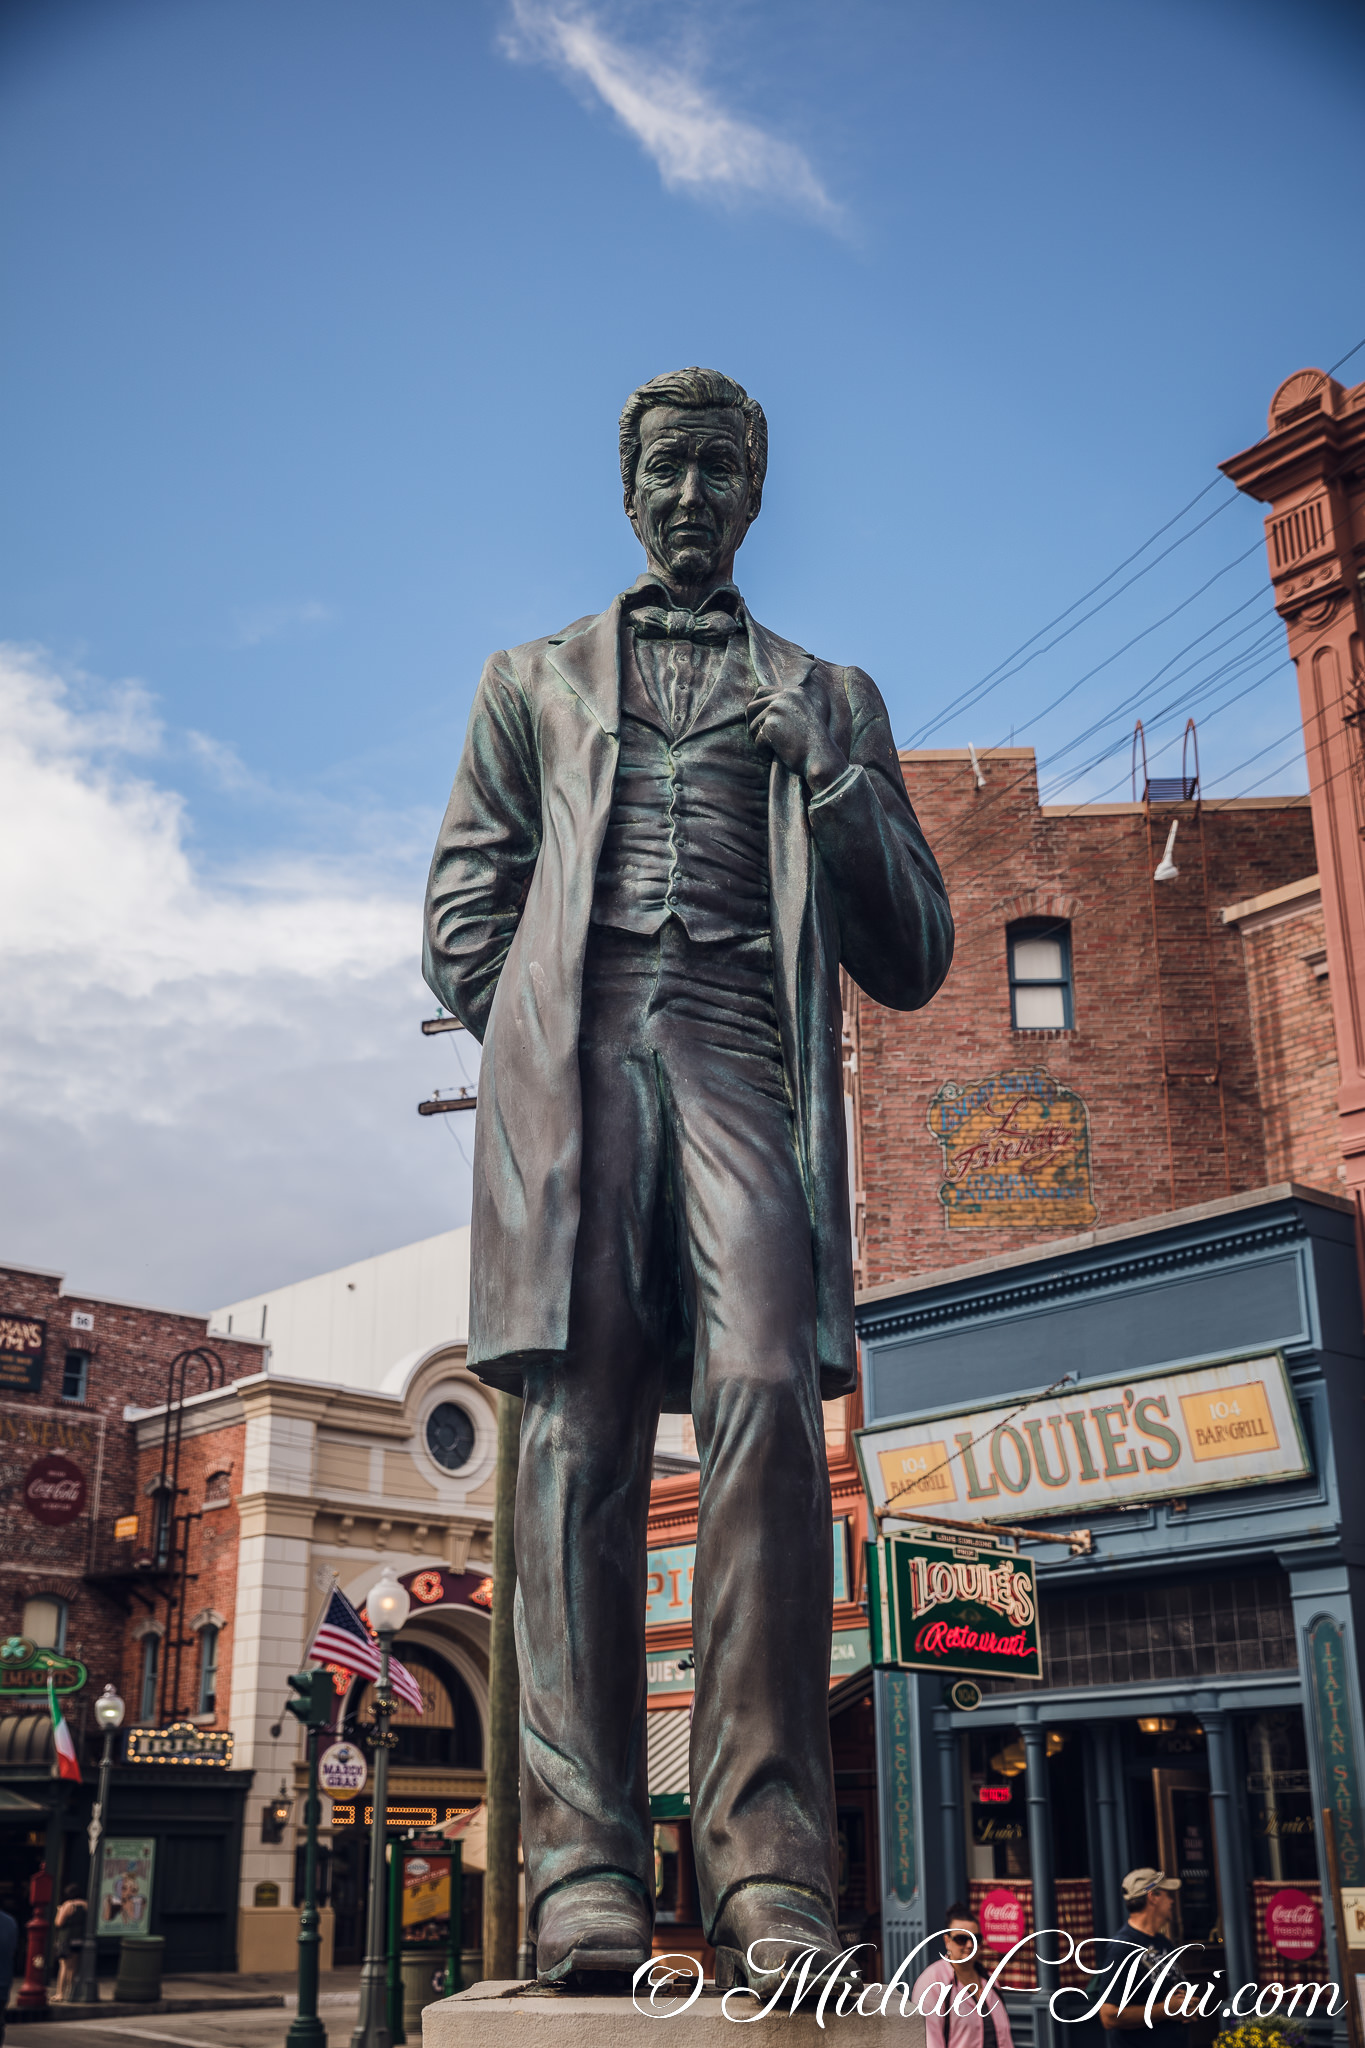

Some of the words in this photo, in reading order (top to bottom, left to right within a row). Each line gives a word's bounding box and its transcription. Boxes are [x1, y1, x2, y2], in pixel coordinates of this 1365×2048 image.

[941, 1080, 995, 1131] ESCORT
[1000, 1072, 1055, 1106] SERVICE
[955, 1187, 1085, 1201] ENTERTAINMENT
[967, 1174, 1037, 1188] GENERAL
[1208, 1399, 1243, 1421] 104
[954, 1389, 1182, 1503] LOUIE'S
[901, 1456, 928, 1475] 104
[908, 1556, 1035, 1628] LOUIE'S
[914, 1621, 1039, 1658] Restaurant
[892, 1681, 906, 1737] VEAL
[1322, 1641, 1346, 1754] ITALIAN
[138, 1736, 224, 1755] IRISH
[894, 1743, 910, 1886] SCALOPPINI
[1333, 1764, 1359, 1881] SAUSAGE
[983, 1902, 1019, 1921] Coca-Cola
[1271, 1904, 1316, 1924] Coca-Cola
